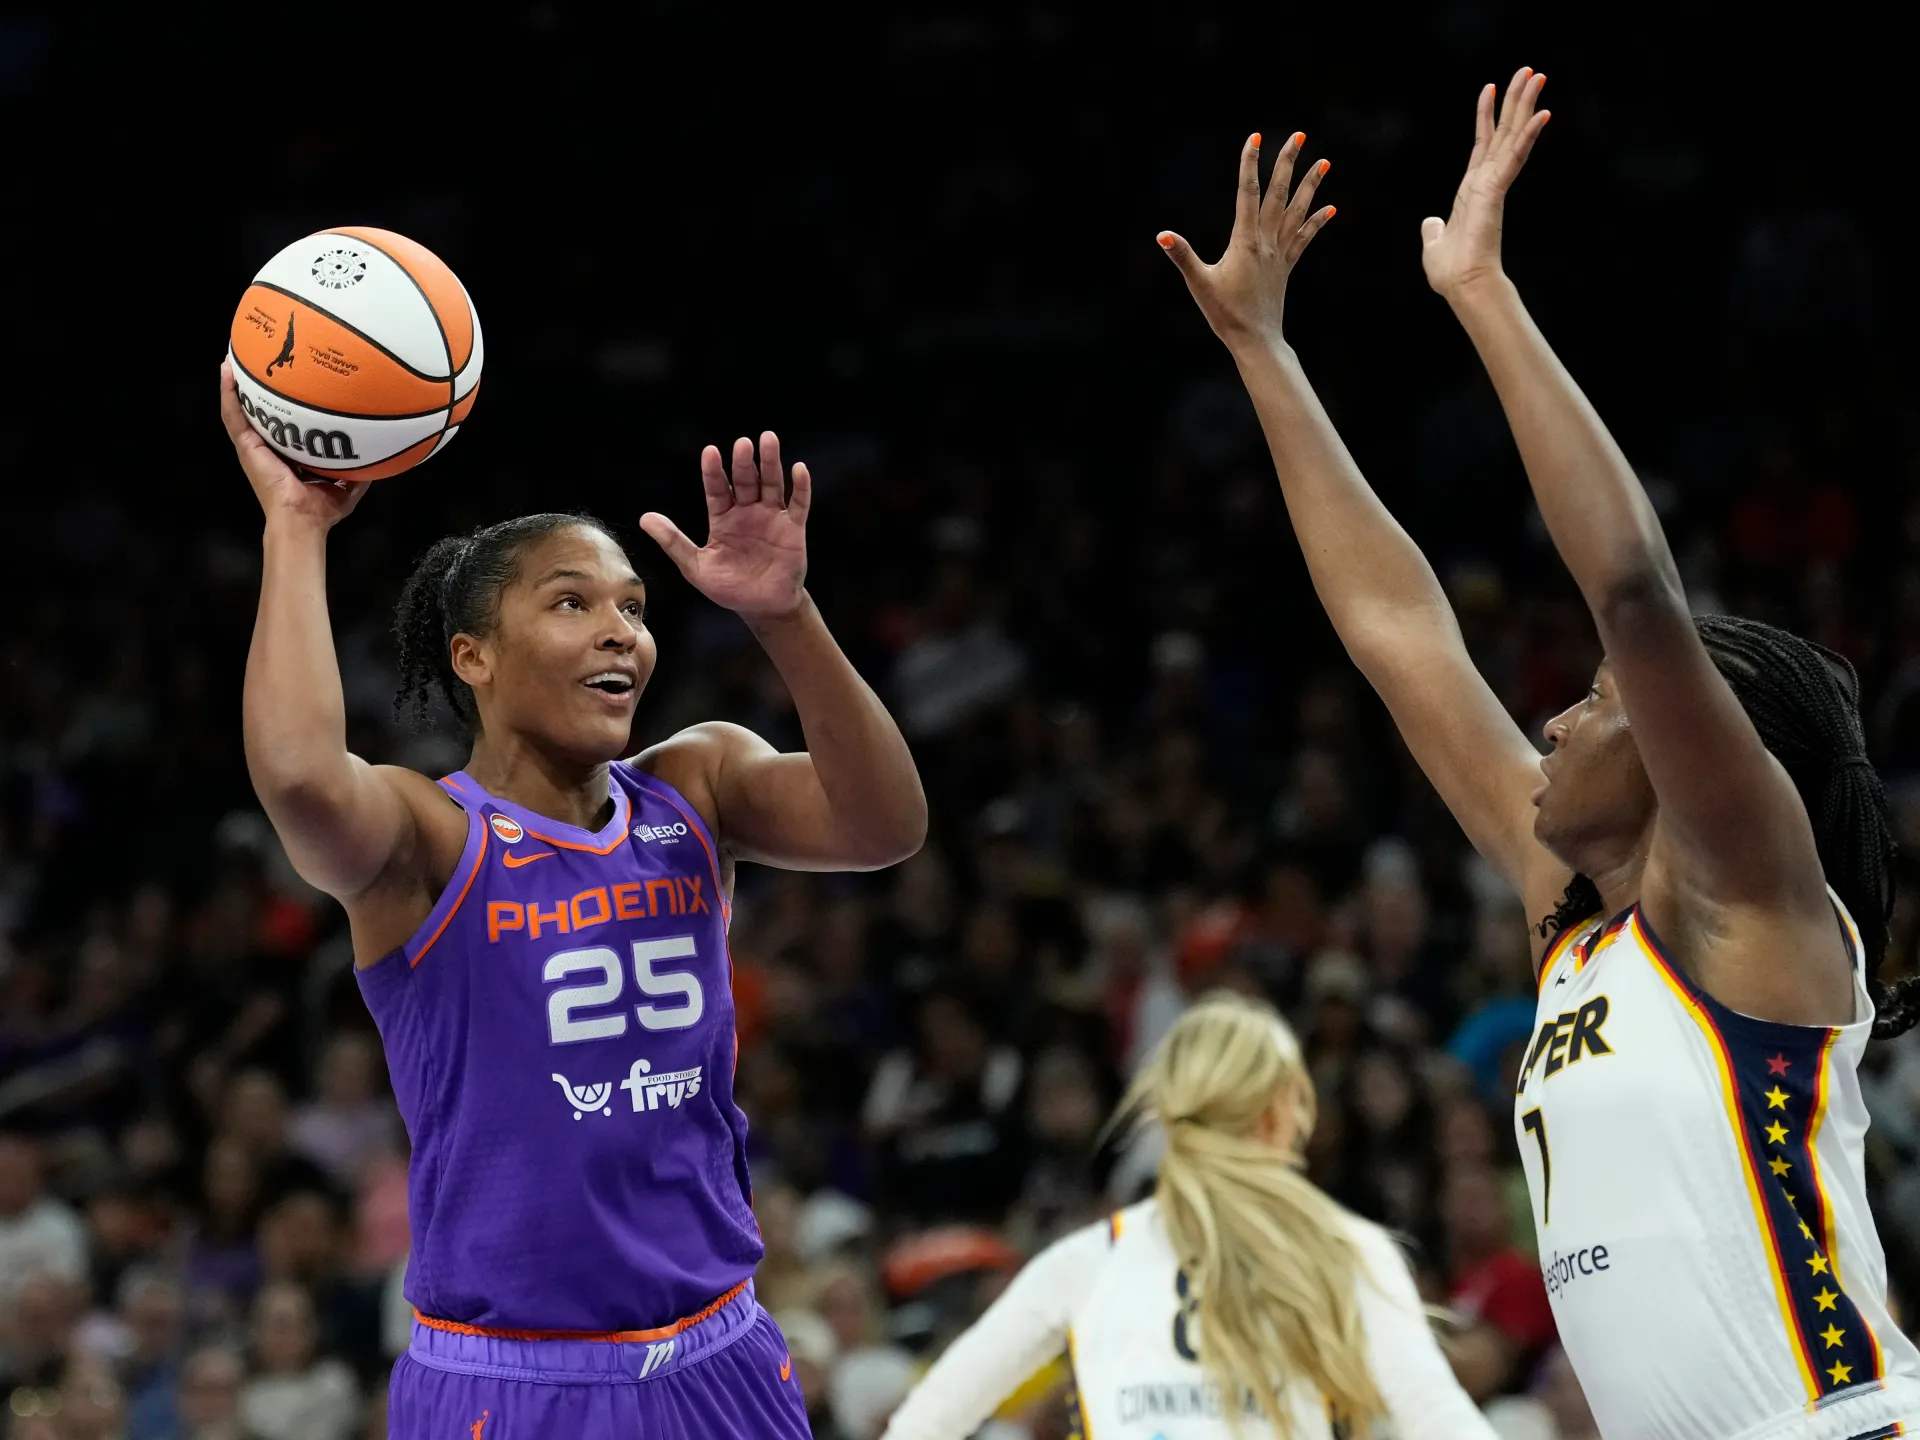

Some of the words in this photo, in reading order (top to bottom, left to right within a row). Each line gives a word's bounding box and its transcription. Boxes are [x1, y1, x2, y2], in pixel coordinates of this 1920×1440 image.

[309, 346, 331, 361] BALL
[331, 355, 359, 372] GAME
[311, 356, 350, 377] OFFICIAL
[239, 390, 360, 459] Wilso
[487, 875, 710, 943] PHOENIX
[542, 934, 704, 1046] 25
[647, 1074, 671, 1084] FOOD
